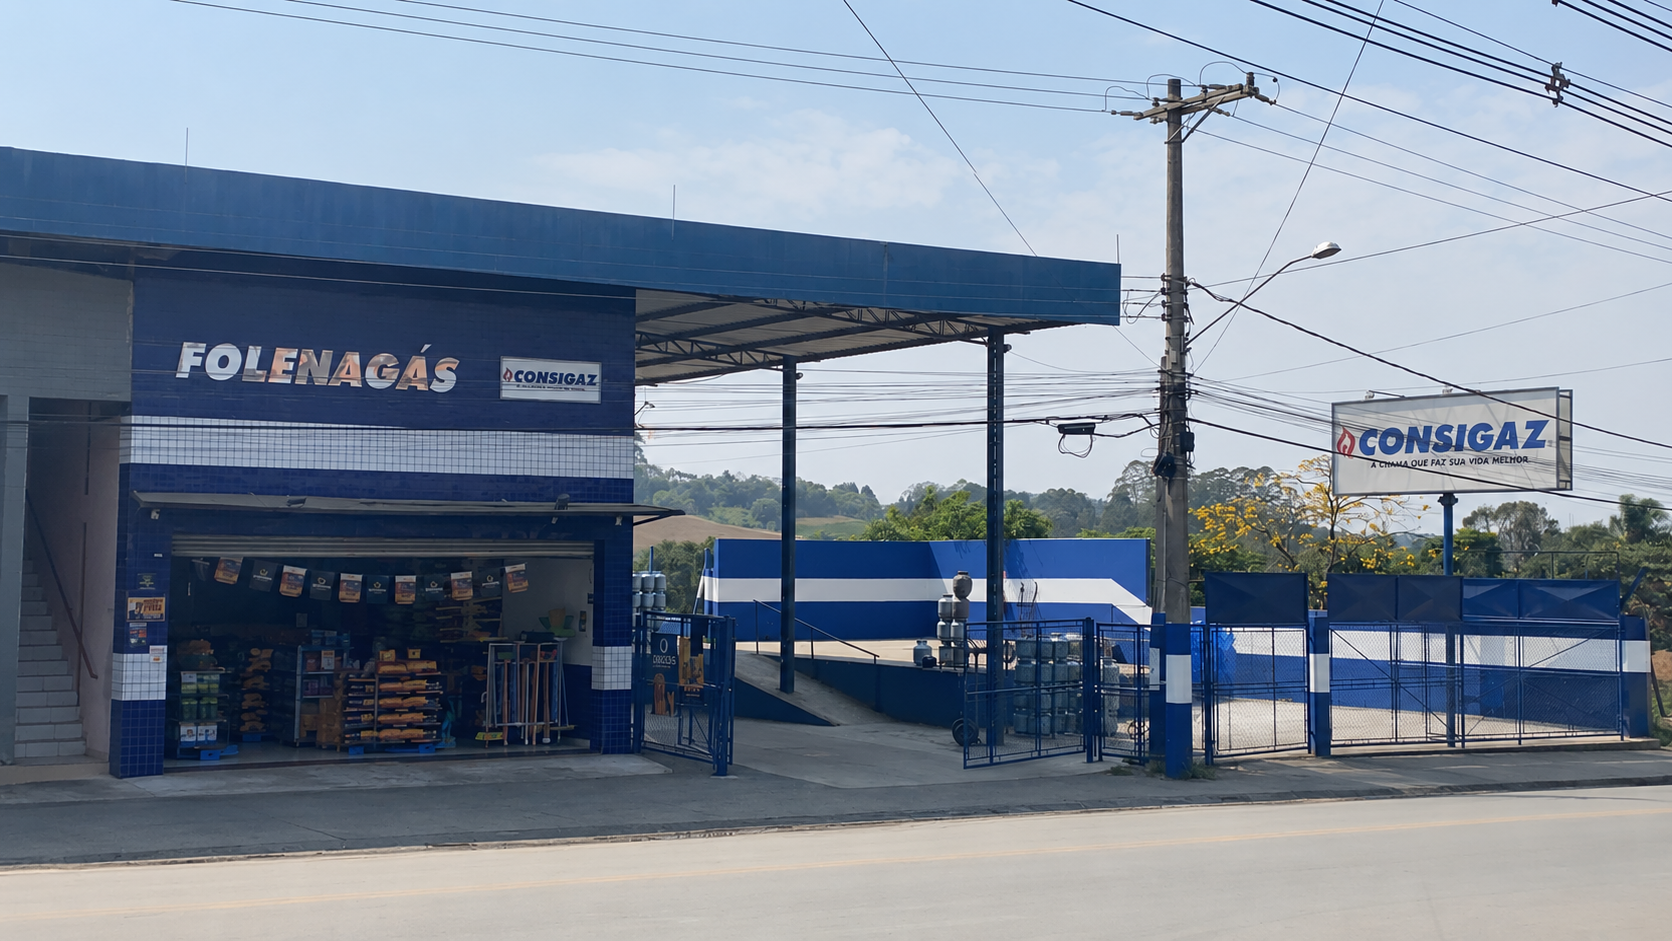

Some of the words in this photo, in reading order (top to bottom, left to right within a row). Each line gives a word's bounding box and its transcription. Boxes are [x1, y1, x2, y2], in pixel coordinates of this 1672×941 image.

[175, 342, 460, 393] FOLENAGÁS
[514, 370, 598, 386] CONSIGAZ
[1359, 419, 1549, 456] CONSIGAZ
[1370, 461, 1377, 469] A
[1410, 458, 1428, 468] QUE
[1430, 458, 1446, 467] FAZ
[1449, 458, 1466, 466] SUA
[1469, 457, 1489, 465] VIDA
[1492, 455, 1529, 465] MELHOR
